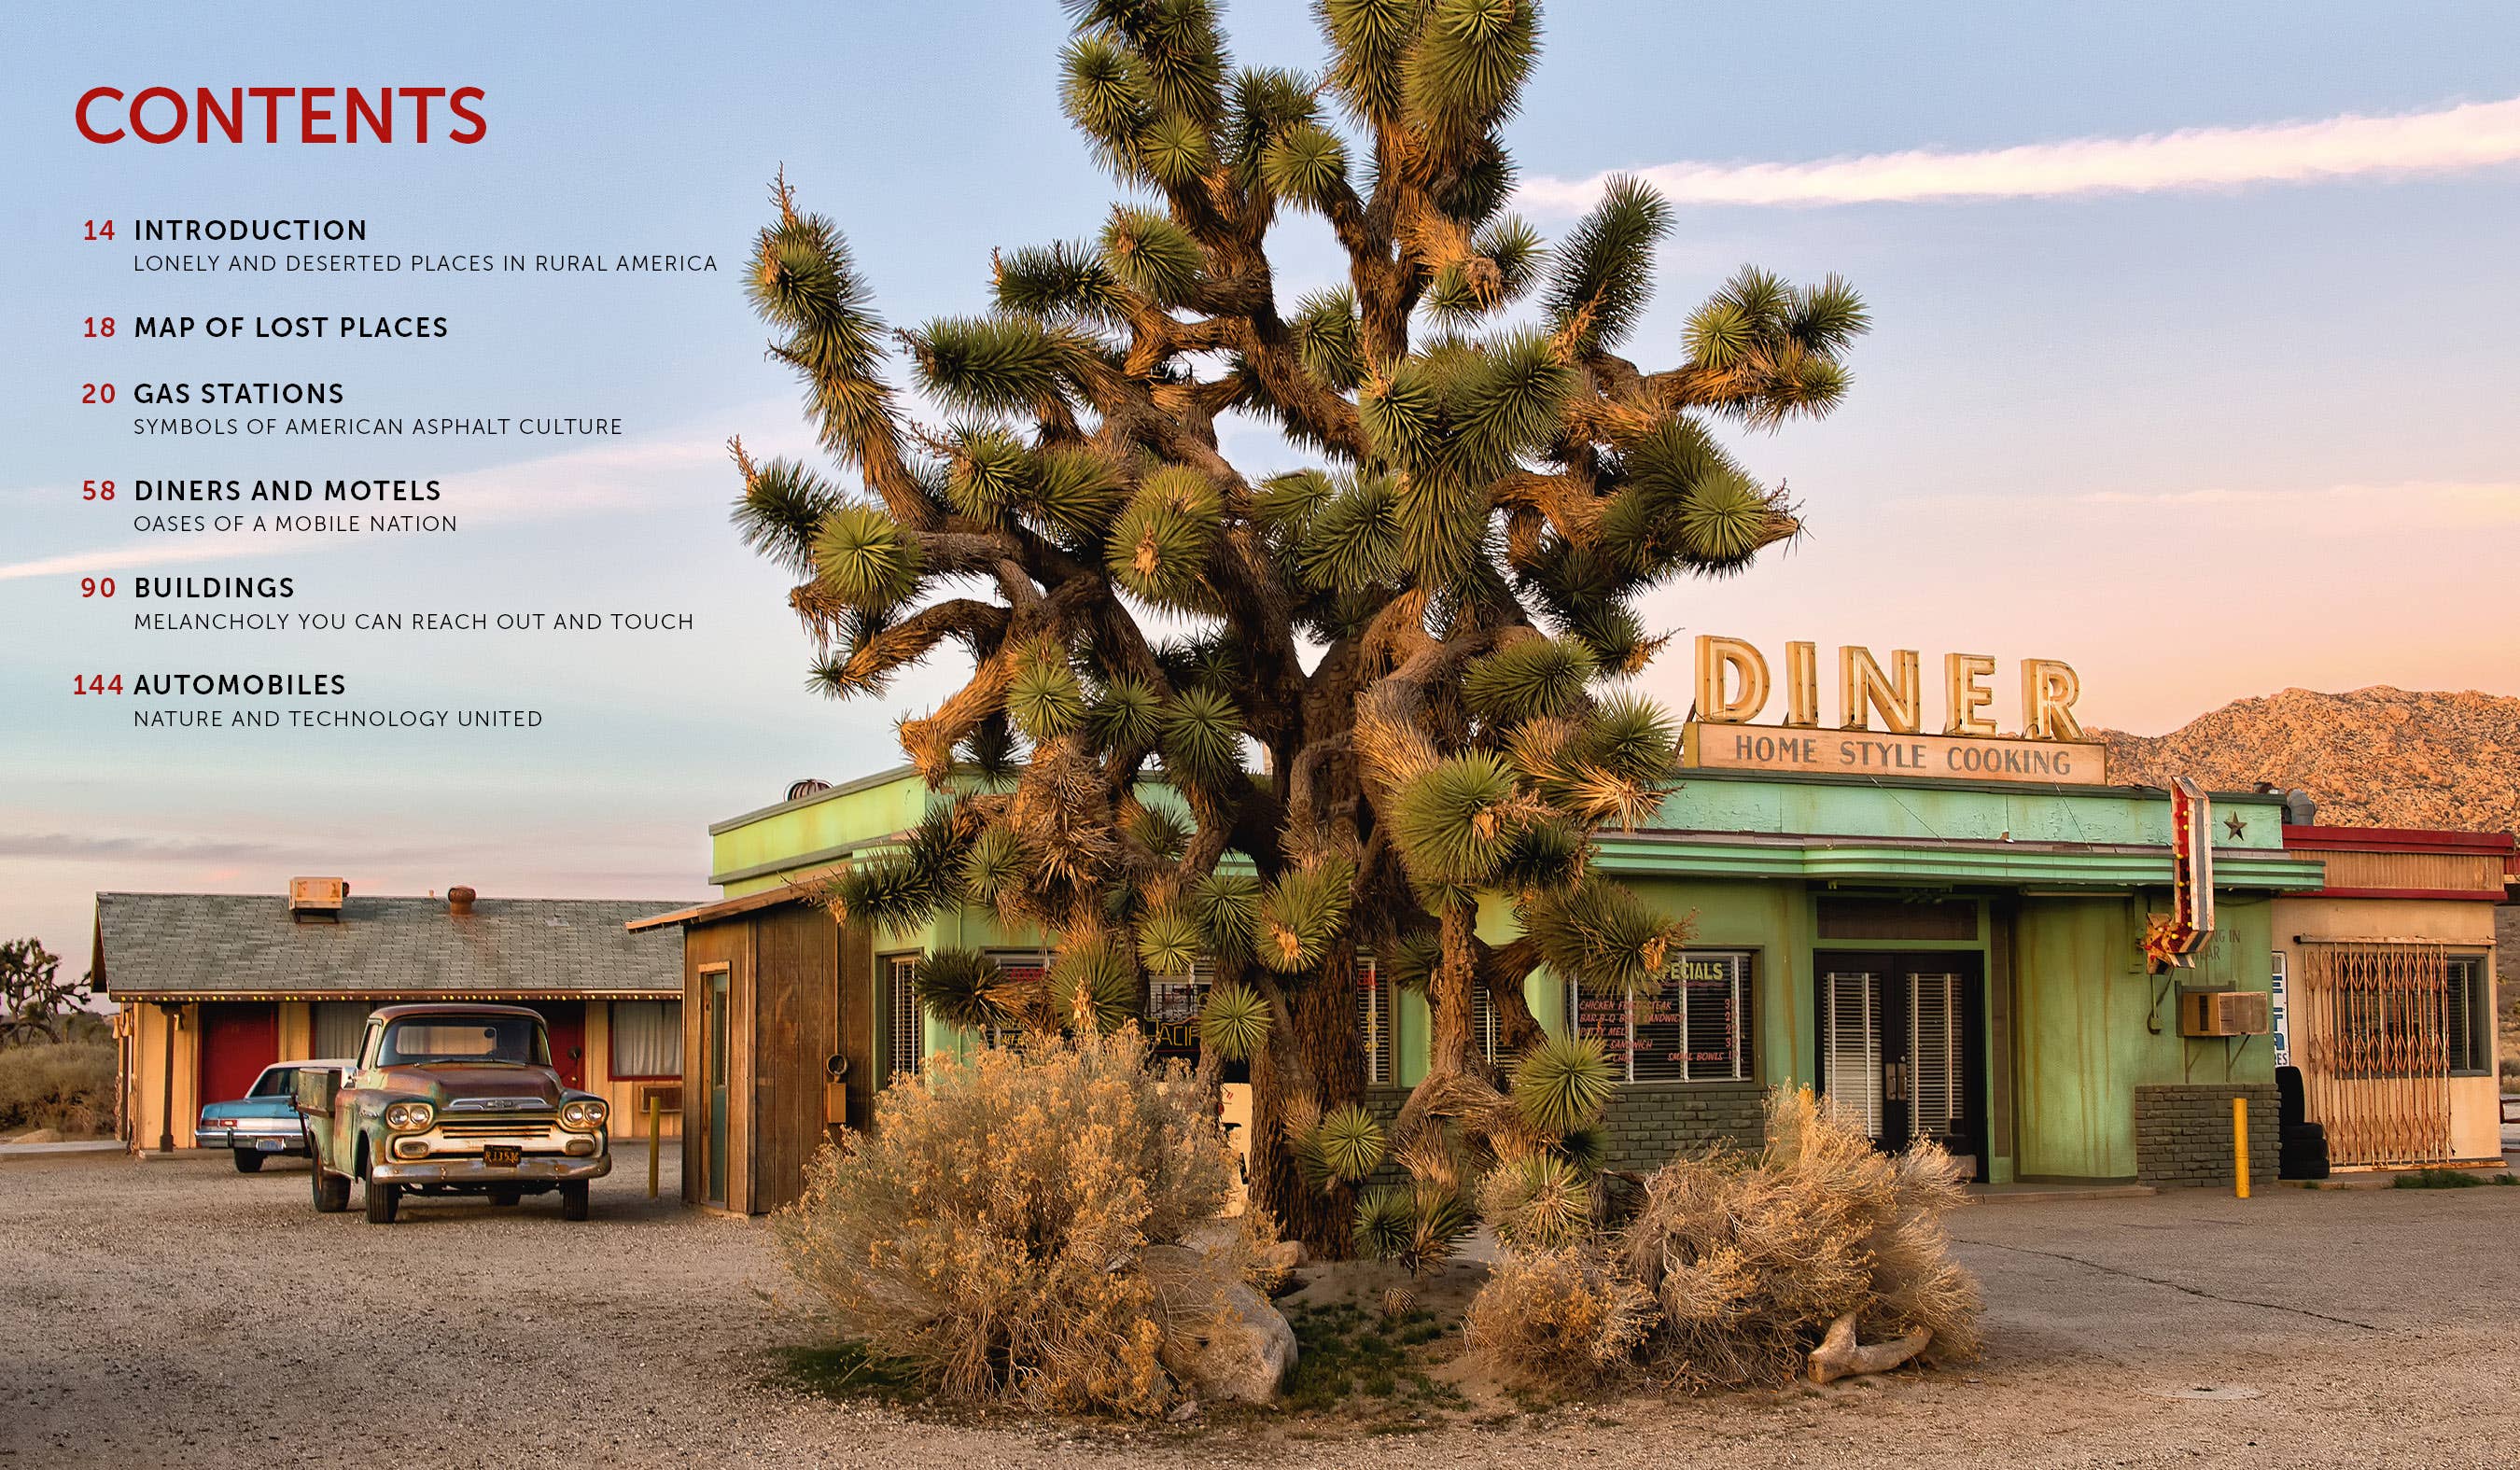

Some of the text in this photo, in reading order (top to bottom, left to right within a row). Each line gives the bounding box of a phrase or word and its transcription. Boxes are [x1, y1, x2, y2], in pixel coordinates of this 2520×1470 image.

[1694, 634, 2089, 742] DINER
[1735, 735, 2071, 776] HOME STYLE COOKING
[1657, 962, 1723, 980] PECIALS
[1578, 1000, 1615, 1011] CHICKEN
